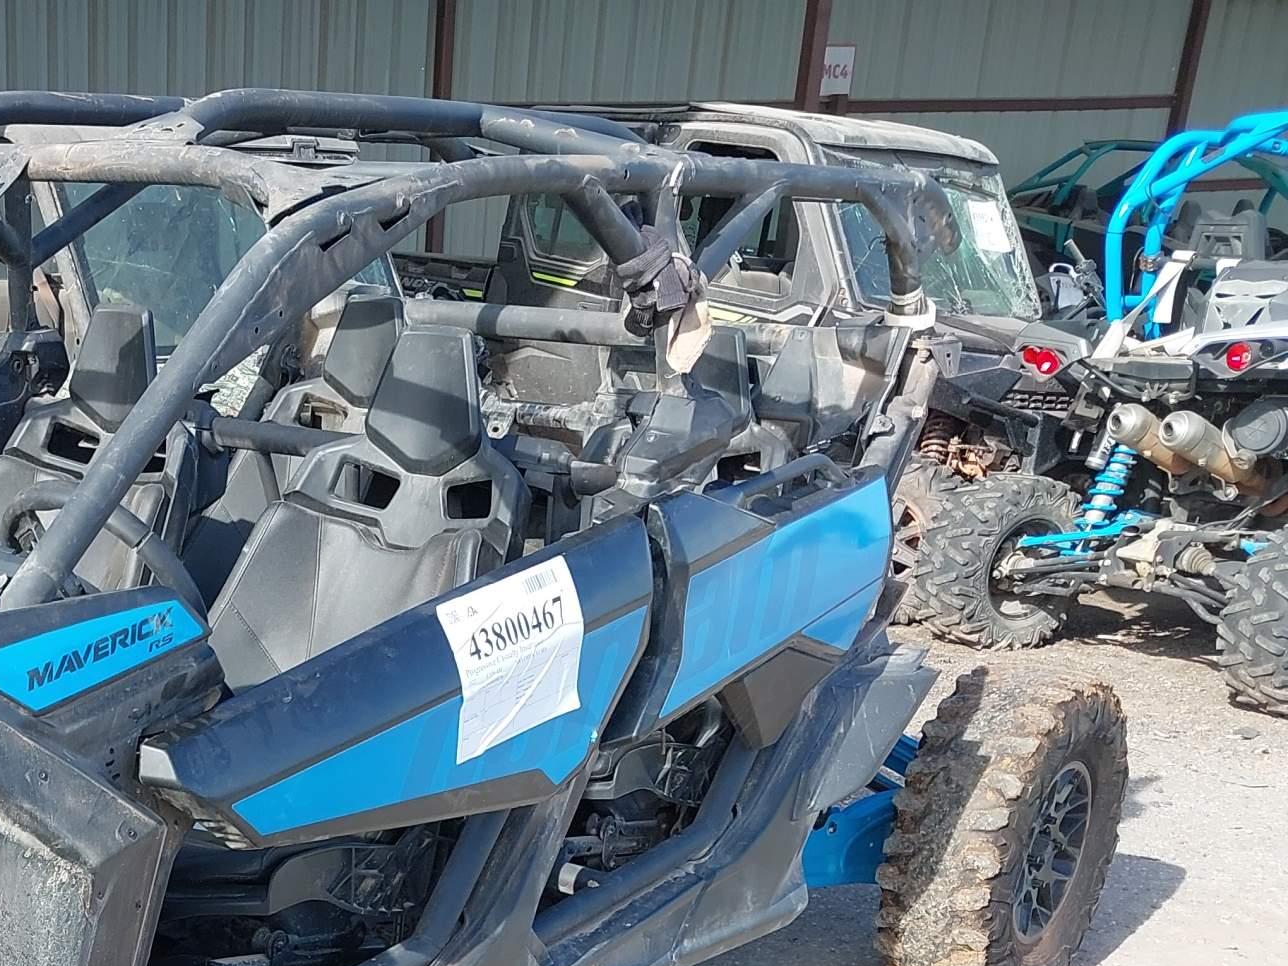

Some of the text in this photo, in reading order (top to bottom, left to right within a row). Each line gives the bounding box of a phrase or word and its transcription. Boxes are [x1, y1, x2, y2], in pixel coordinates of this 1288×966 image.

[823, 63, 848, 79] MC4
[469, 595, 564, 661] 43800467
[148, 631, 174, 653] RS
